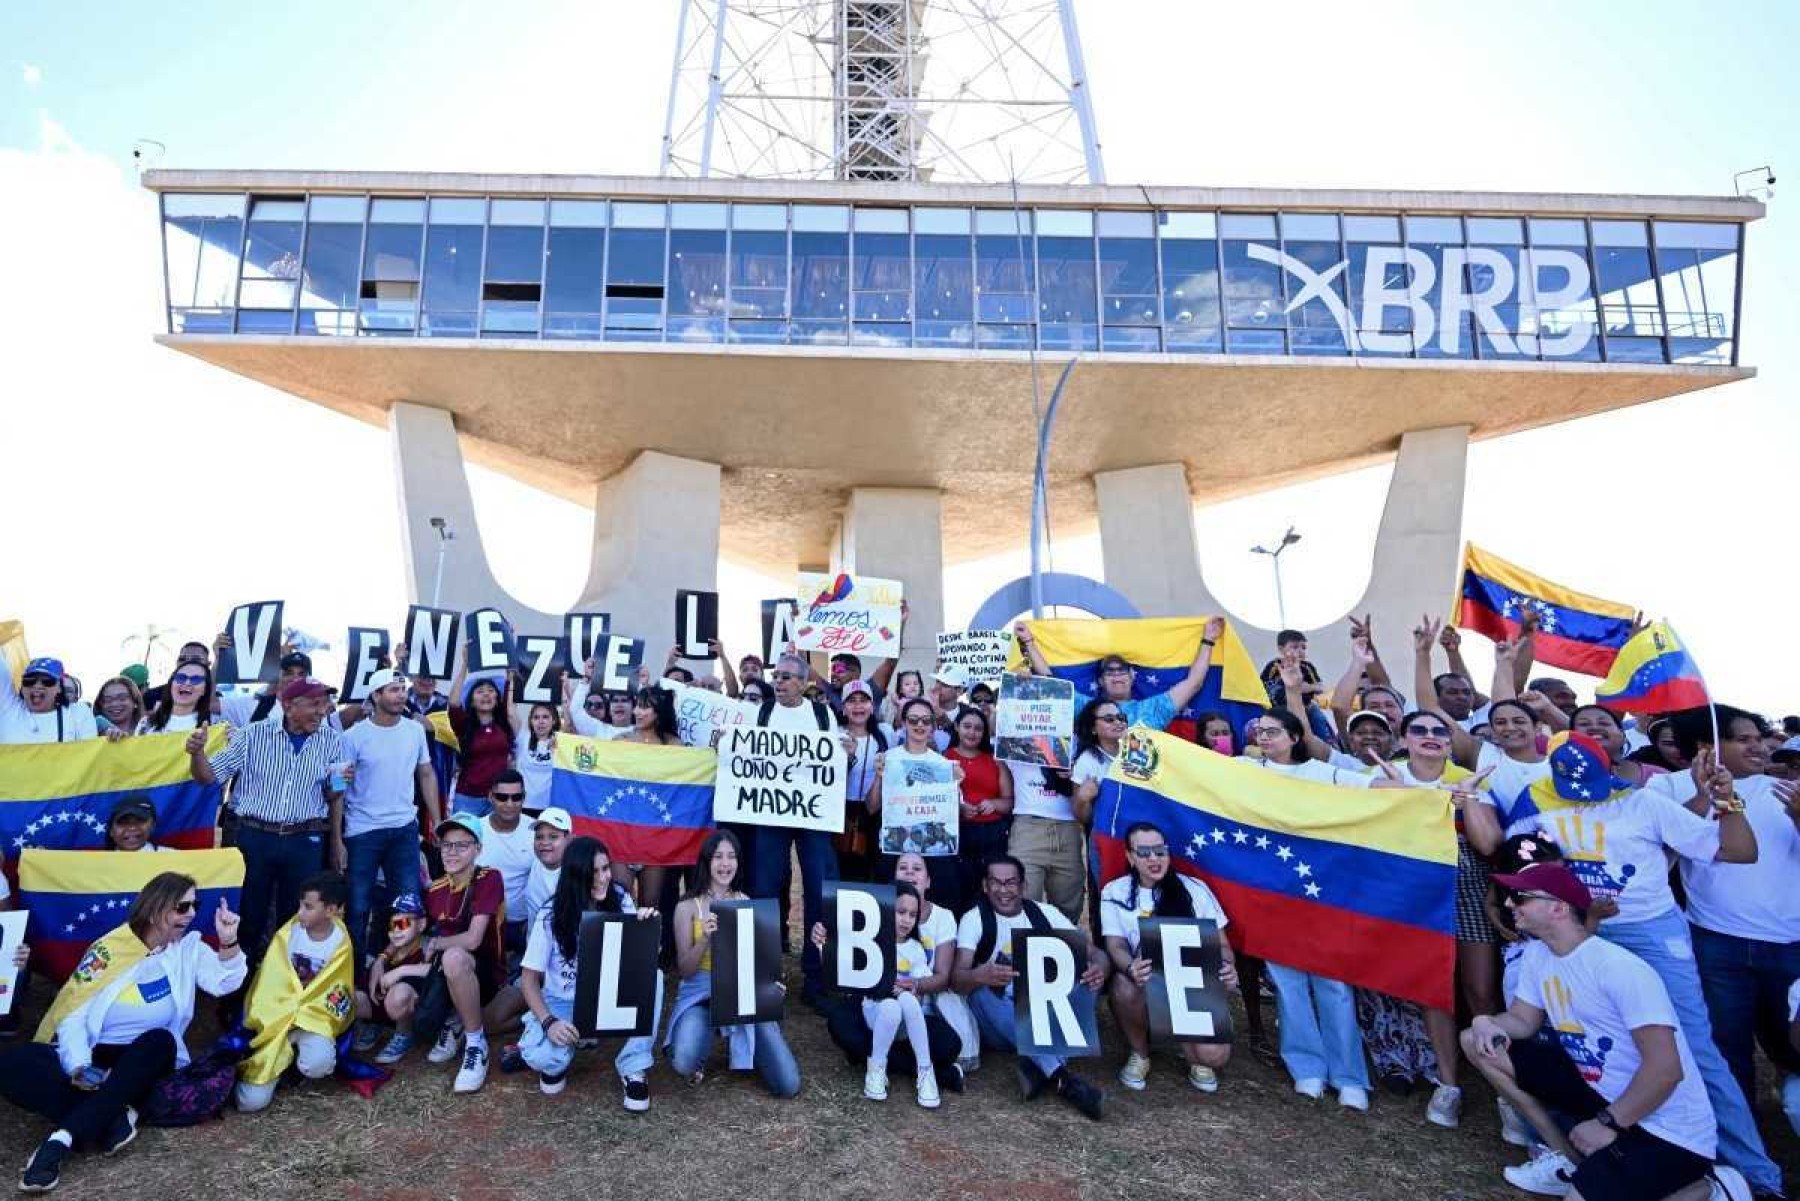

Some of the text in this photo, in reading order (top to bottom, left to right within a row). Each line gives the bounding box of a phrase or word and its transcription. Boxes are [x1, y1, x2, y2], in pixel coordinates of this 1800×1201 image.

[1361, 246, 1595, 356] BRB
[938, 630, 999, 644] DESDE BRASIL
[940, 642, 1000, 655] APOYANDO A
[731, 728, 834, 762] MADURO
[731, 755, 778, 781] COÑO
[805, 764, 835, 787] TU
[737, 786, 824, 819] MADRE
[837, 888, 884, 989] B
[596, 921, 638, 1031] L
[1027, 936, 1088, 1048] R
[1159, 923, 1216, 1037] E
